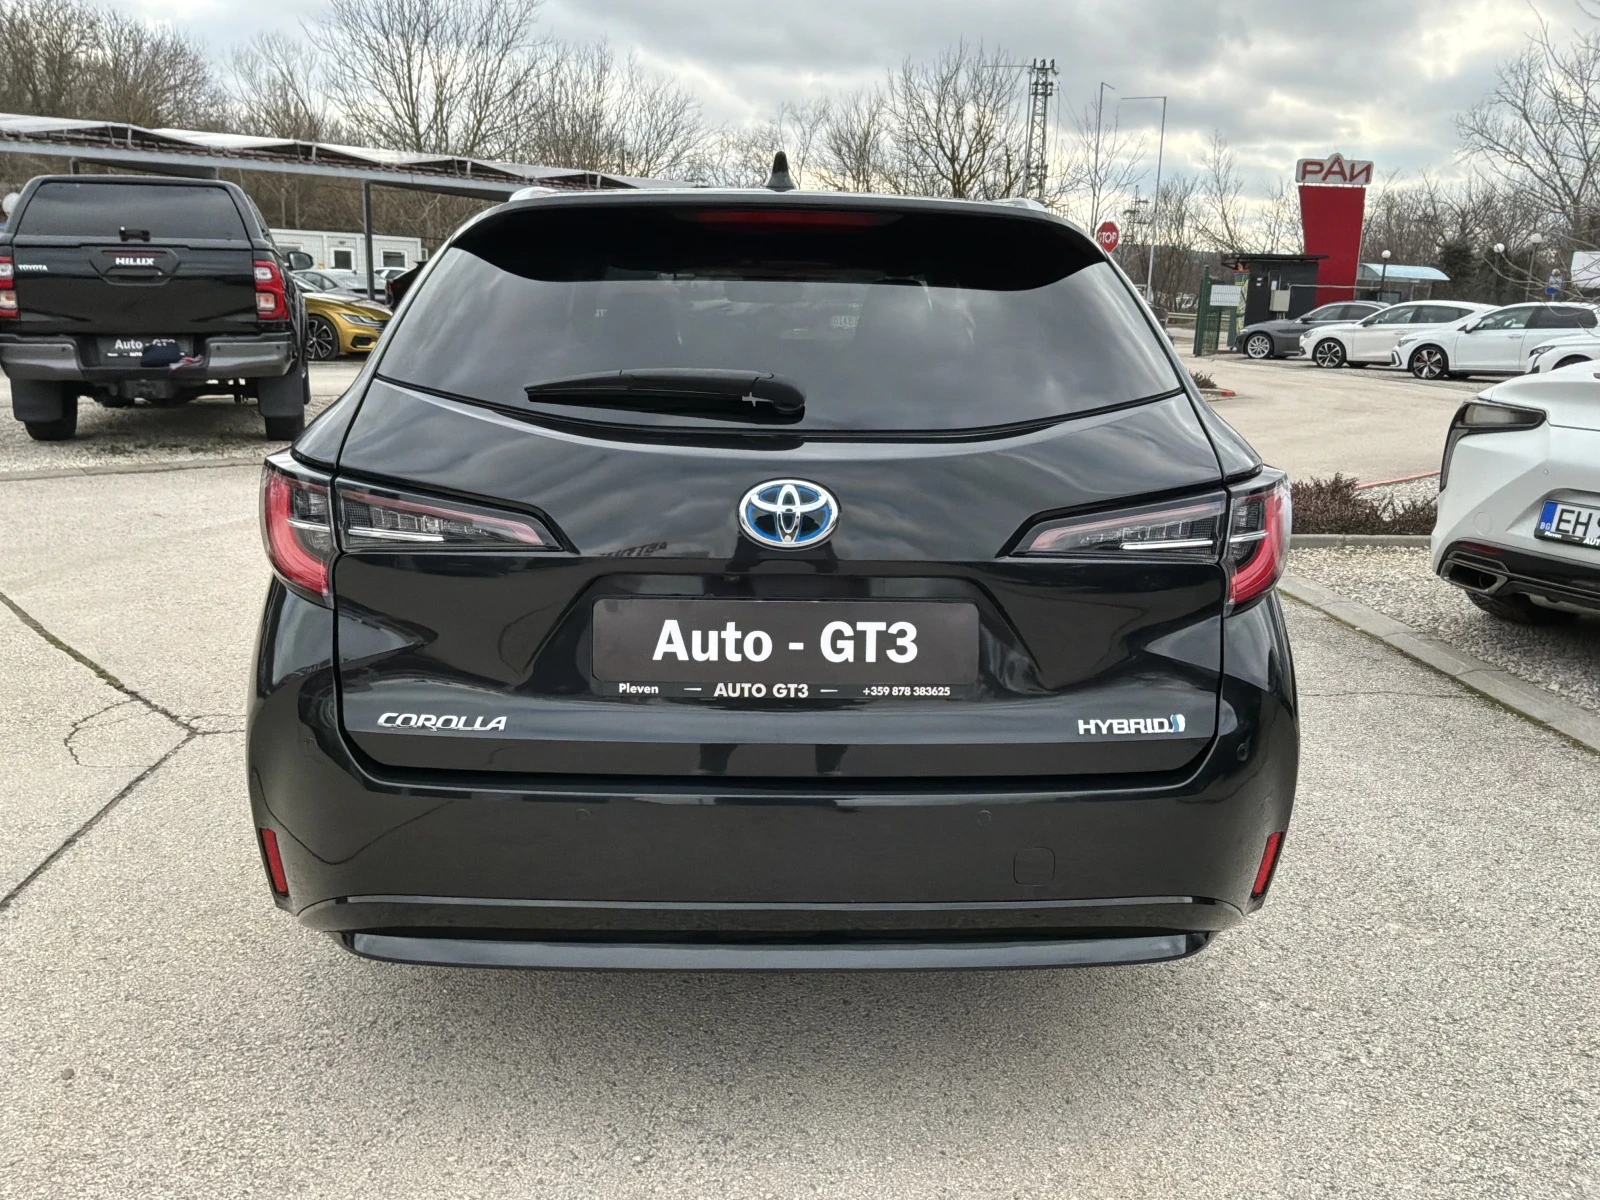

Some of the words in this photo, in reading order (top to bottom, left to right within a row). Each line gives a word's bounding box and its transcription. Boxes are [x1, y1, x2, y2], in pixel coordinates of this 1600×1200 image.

[1098, 231, 1117, 243] STOP
[115, 257, 155, 266] HILUX
[115, 339, 143, 349] Auto
[652, 619, 773, 662] Auto
[820, 621, 918, 664] GT3
[618, 683, 659, 695] Pleven
[713, 683, 766, 698] AUTO
[772, 683, 809, 699] GT3
[862, 688, 890, 696] +359
[891, 687, 912, 696] 878
[913, 687, 950, 696] 383625
[377, 712, 507, 732] COROLLA
[1078, 717, 1170, 734] HYBRID
